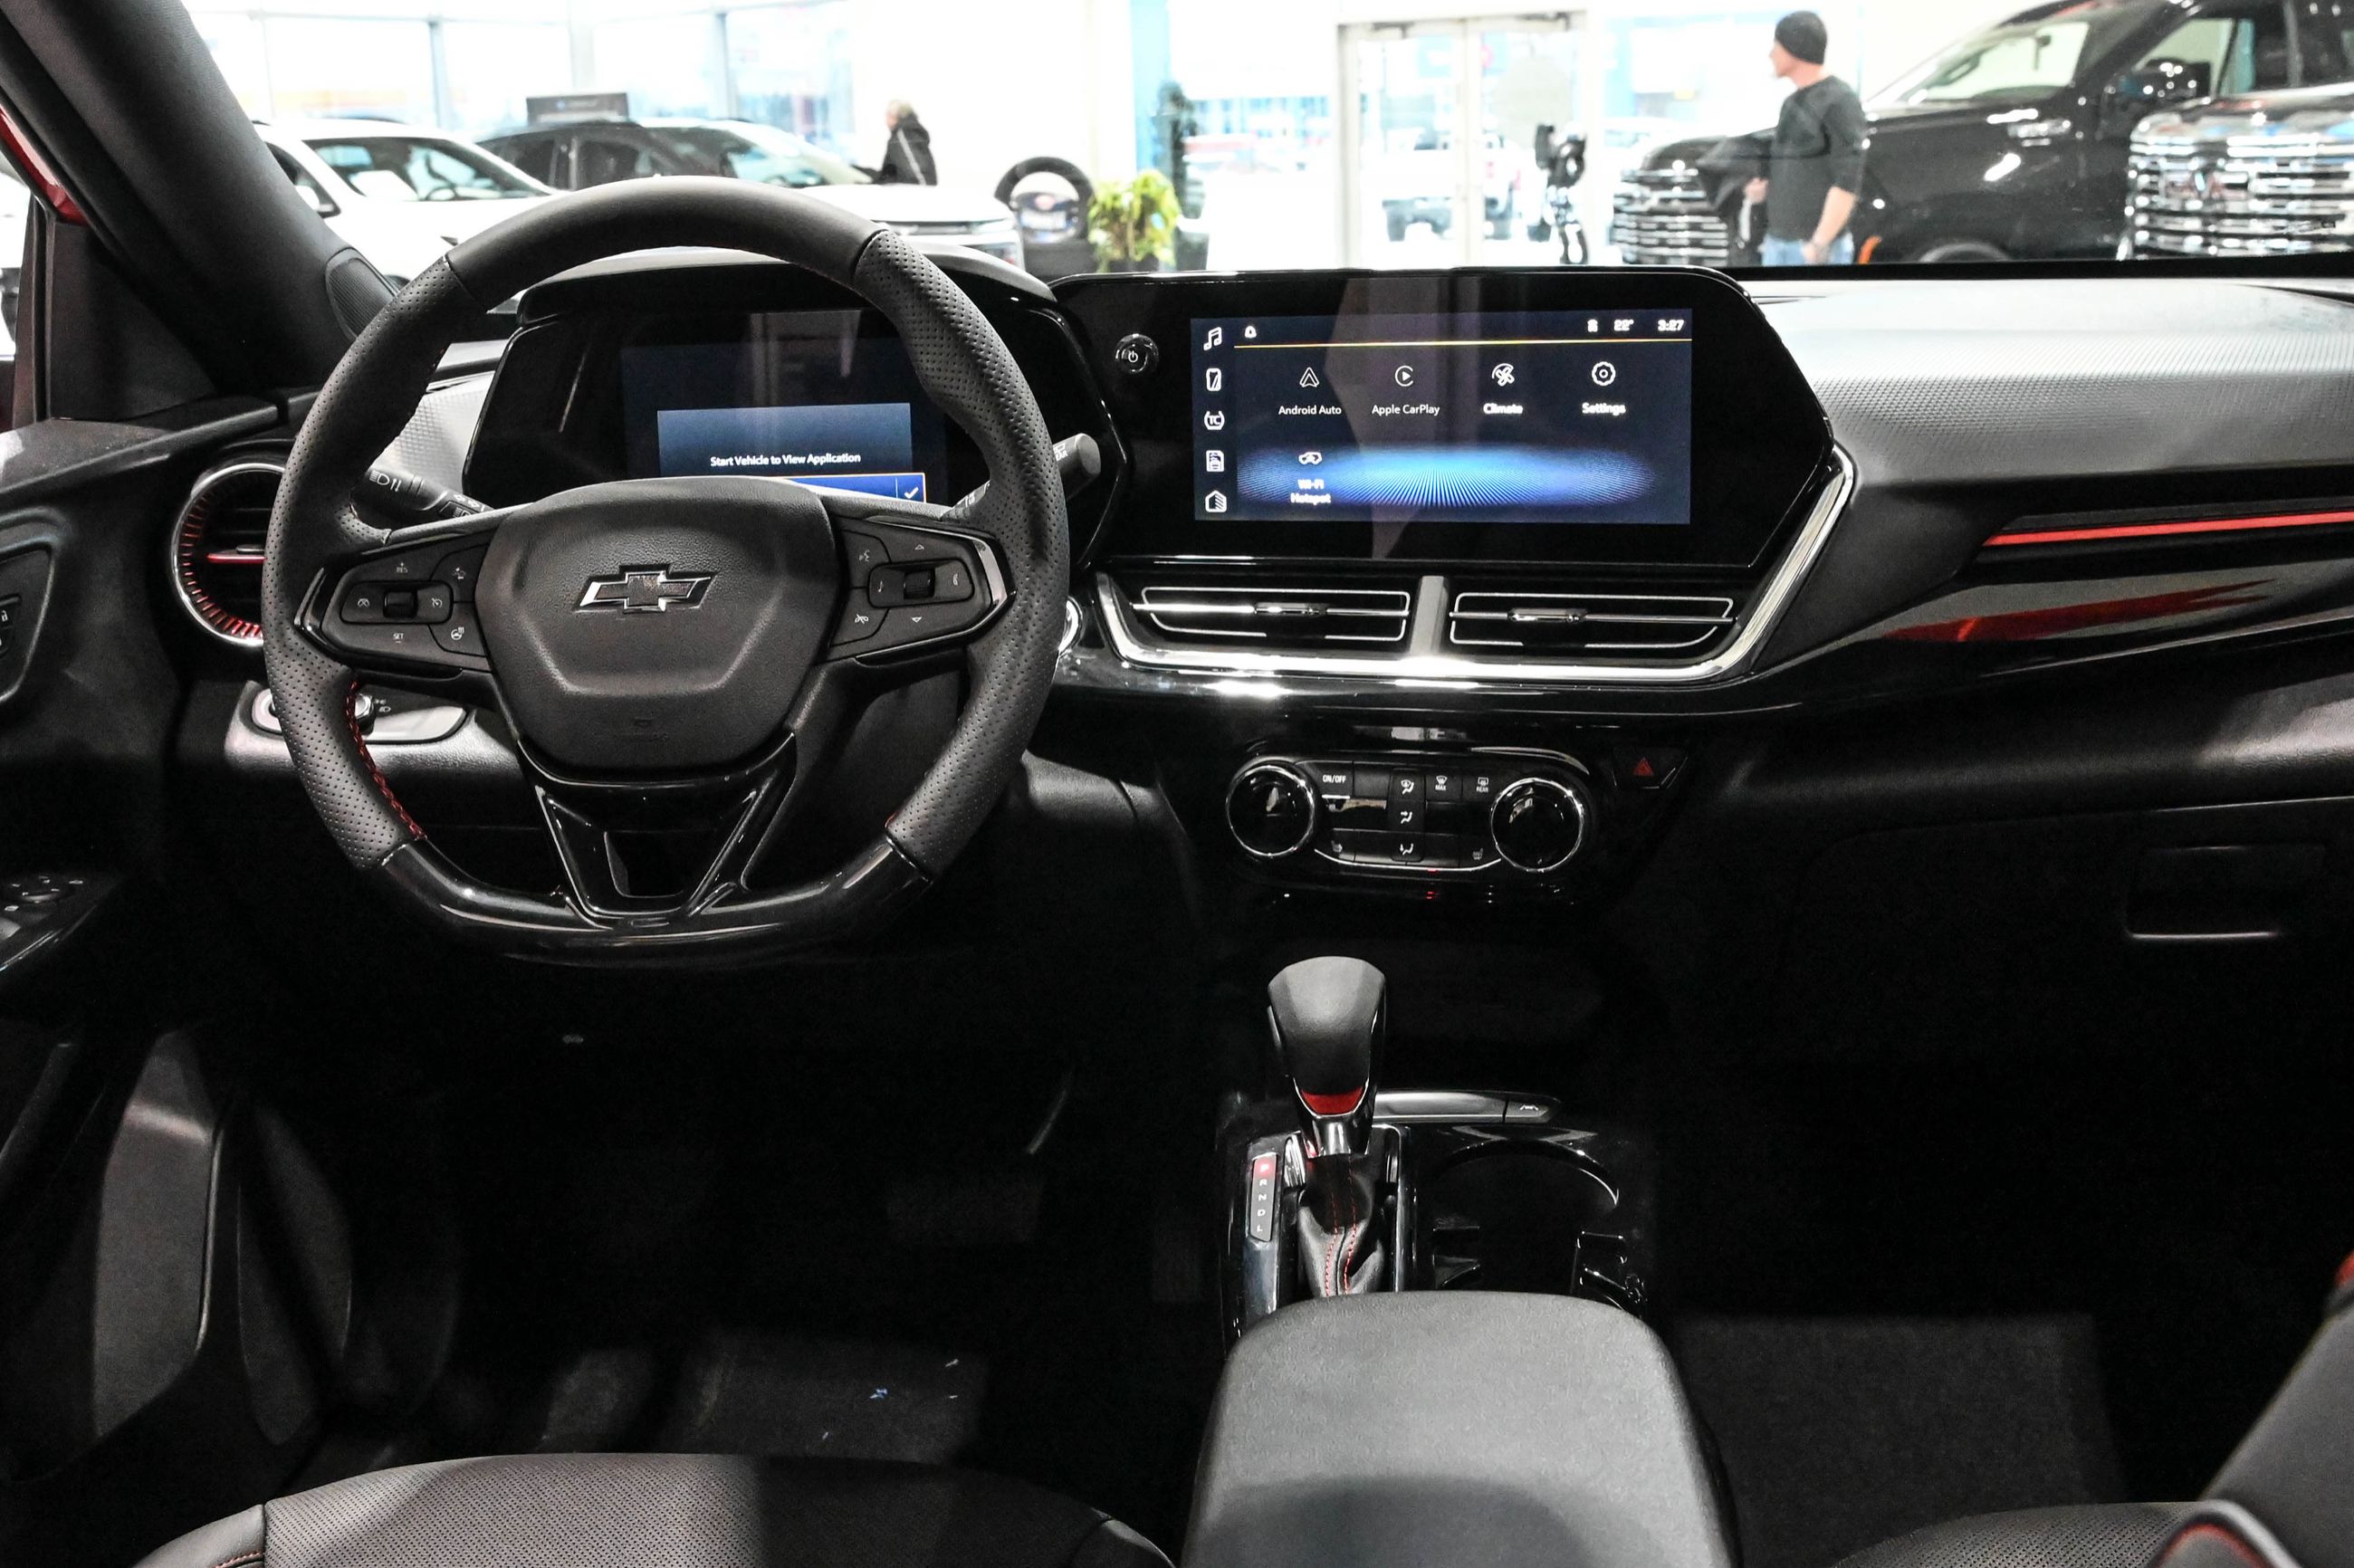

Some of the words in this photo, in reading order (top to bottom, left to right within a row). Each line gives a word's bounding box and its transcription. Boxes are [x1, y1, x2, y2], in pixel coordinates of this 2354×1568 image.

[1658, 319, 1684, 331] 3:27
[1278, 405, 1316, 415] Android
[1318, 406, 1342, 415] Auto
[1372, 405, 1401, 416] Apple
[1402, 404, 1440, 416] CarPlay
[1483, 403, 1524, 415] Climate
[1582, 402, 1626, 416] Settings
[710, 456, 733, 467] Start
[734, 455, 769, 466] Vehicle
[770, 455, 781, 465] to
[782, 454, 806, 464] View
[807, 453, 861, 466] Application
[1297, 479, 1325, 490] Wi-Fi
[1289, 492, 1332, 506] Hotspot
[1322, 774, 1346, 784] ON/OFF
[1258, 1193, 1267, 1201] N
[1258, 1209, 1266, 1217] D
[1257, 1224, 1262, 1232] L
